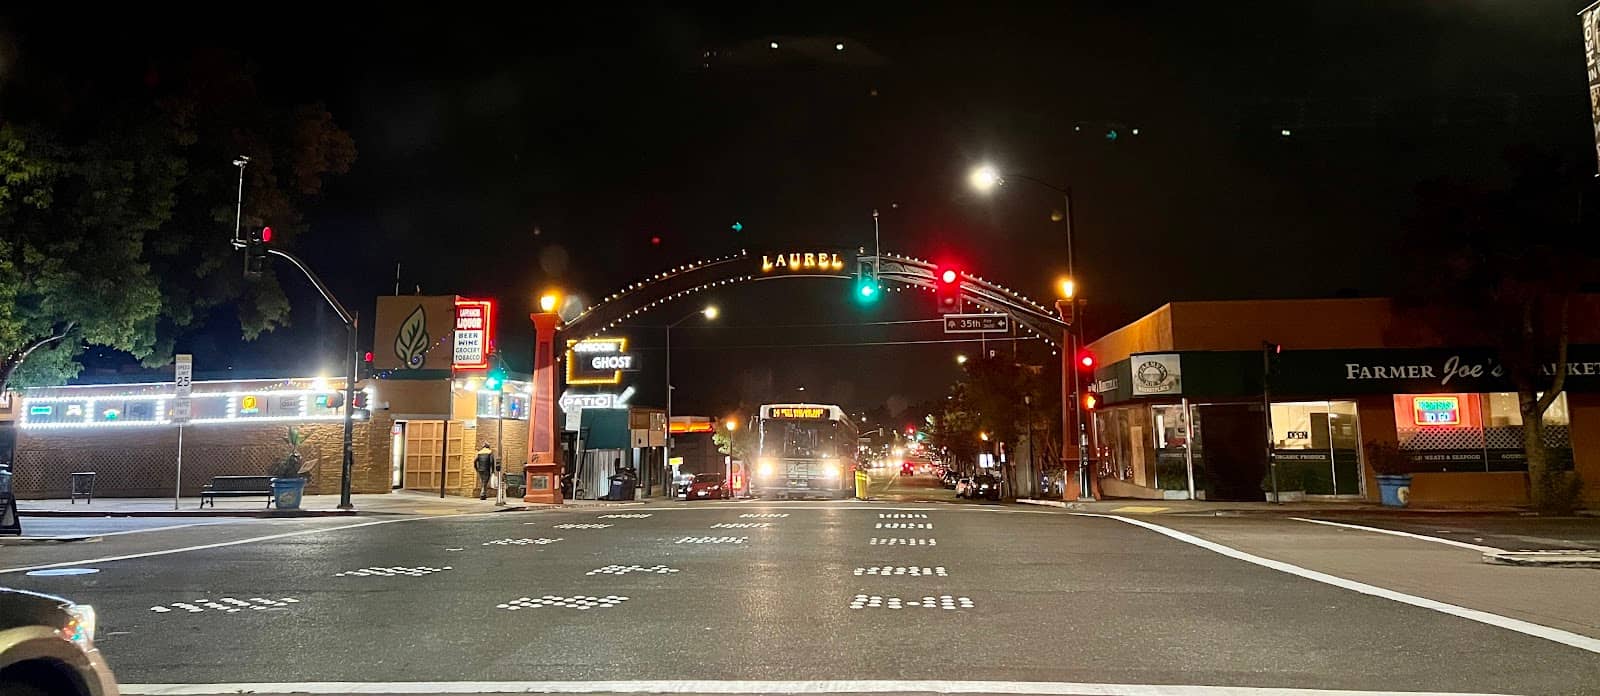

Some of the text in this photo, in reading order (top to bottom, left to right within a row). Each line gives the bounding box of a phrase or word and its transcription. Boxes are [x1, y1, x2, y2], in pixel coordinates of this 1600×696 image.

[762, 253, 844, 271] LAUREL
[457, 318, 481, 329] LIQUOR
[960, 319, 980, 328] 35th
[592, 356, 632, 369] GHOST
[1345, 363, 1436, 379] FARMER
[1441, 355, 1504, 386] Joe's
[177, 376, 190, 387] 25
[563, 397, 607, 406] PATIO
[1423, 412, 1450, 422] TO GO
[1287, 431, 1308, 440] OPEN
